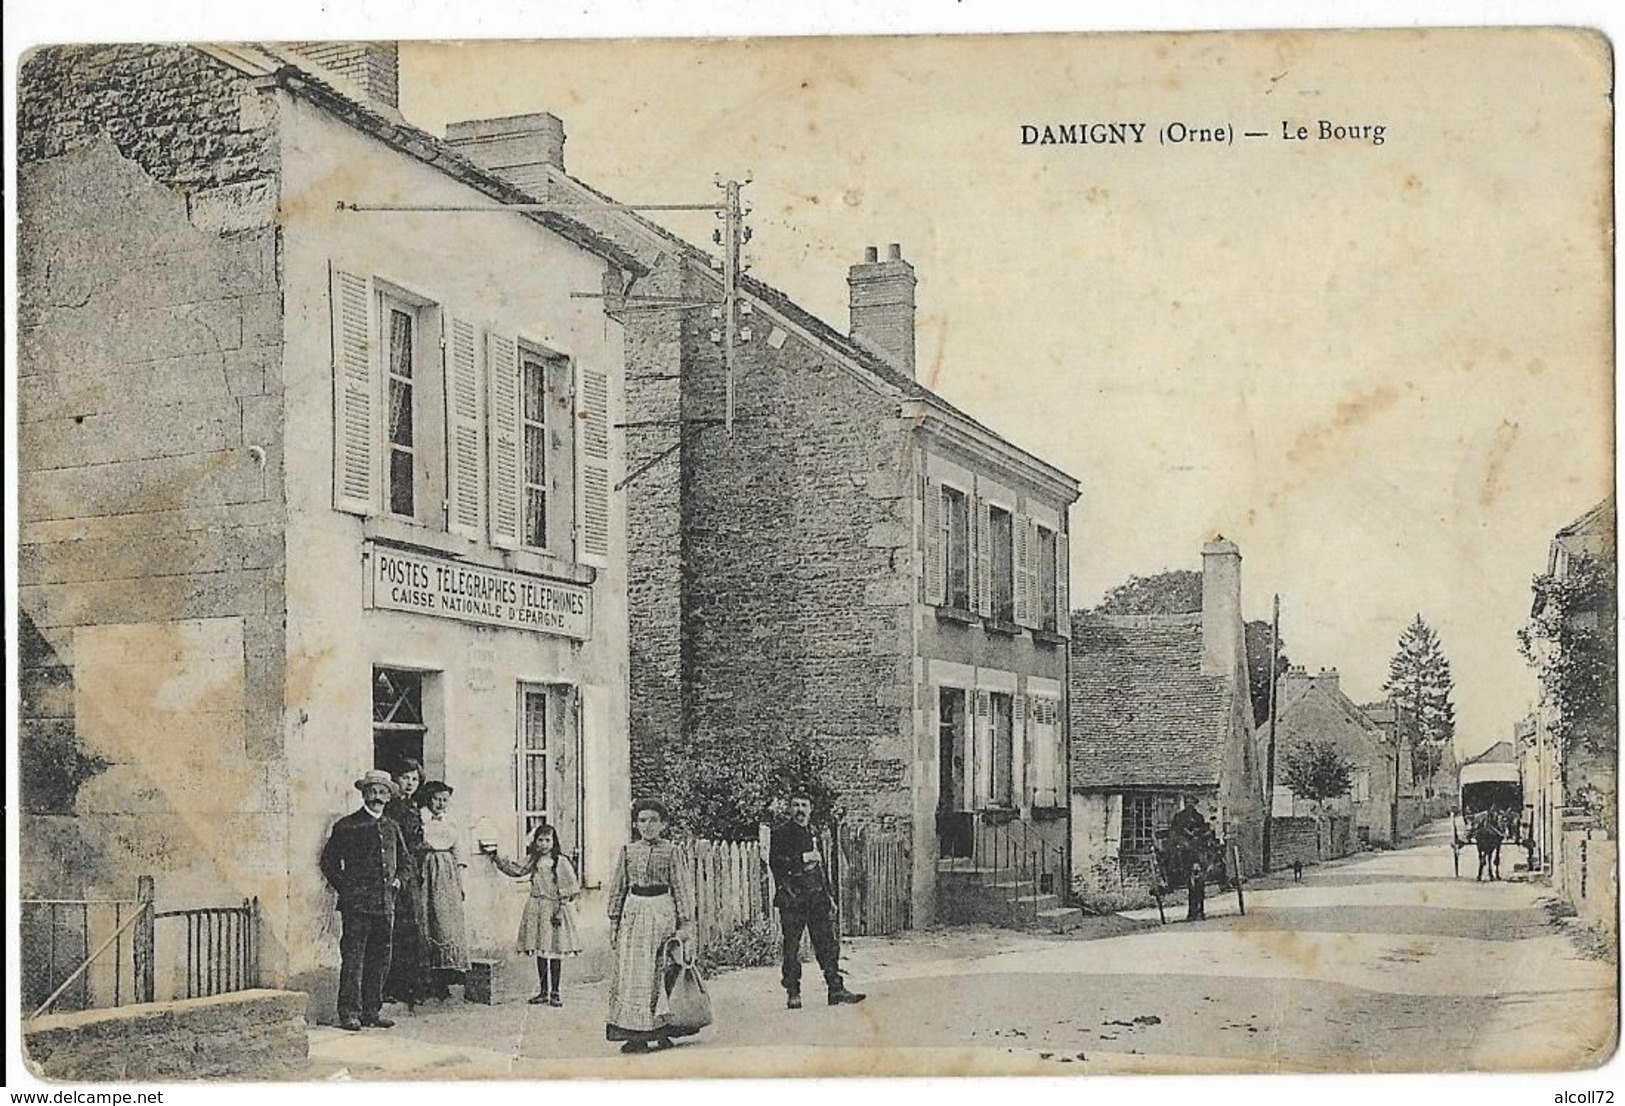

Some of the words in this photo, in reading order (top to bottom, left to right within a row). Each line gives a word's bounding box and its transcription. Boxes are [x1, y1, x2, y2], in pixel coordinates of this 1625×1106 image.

[380, 556, 429, 589] POSTES
[436, 564, 517, 604] TÉLÉGRAPHES
[391, 587, 435, 608] CAISSE
[441, 595, 502, 618] NATIONALE
